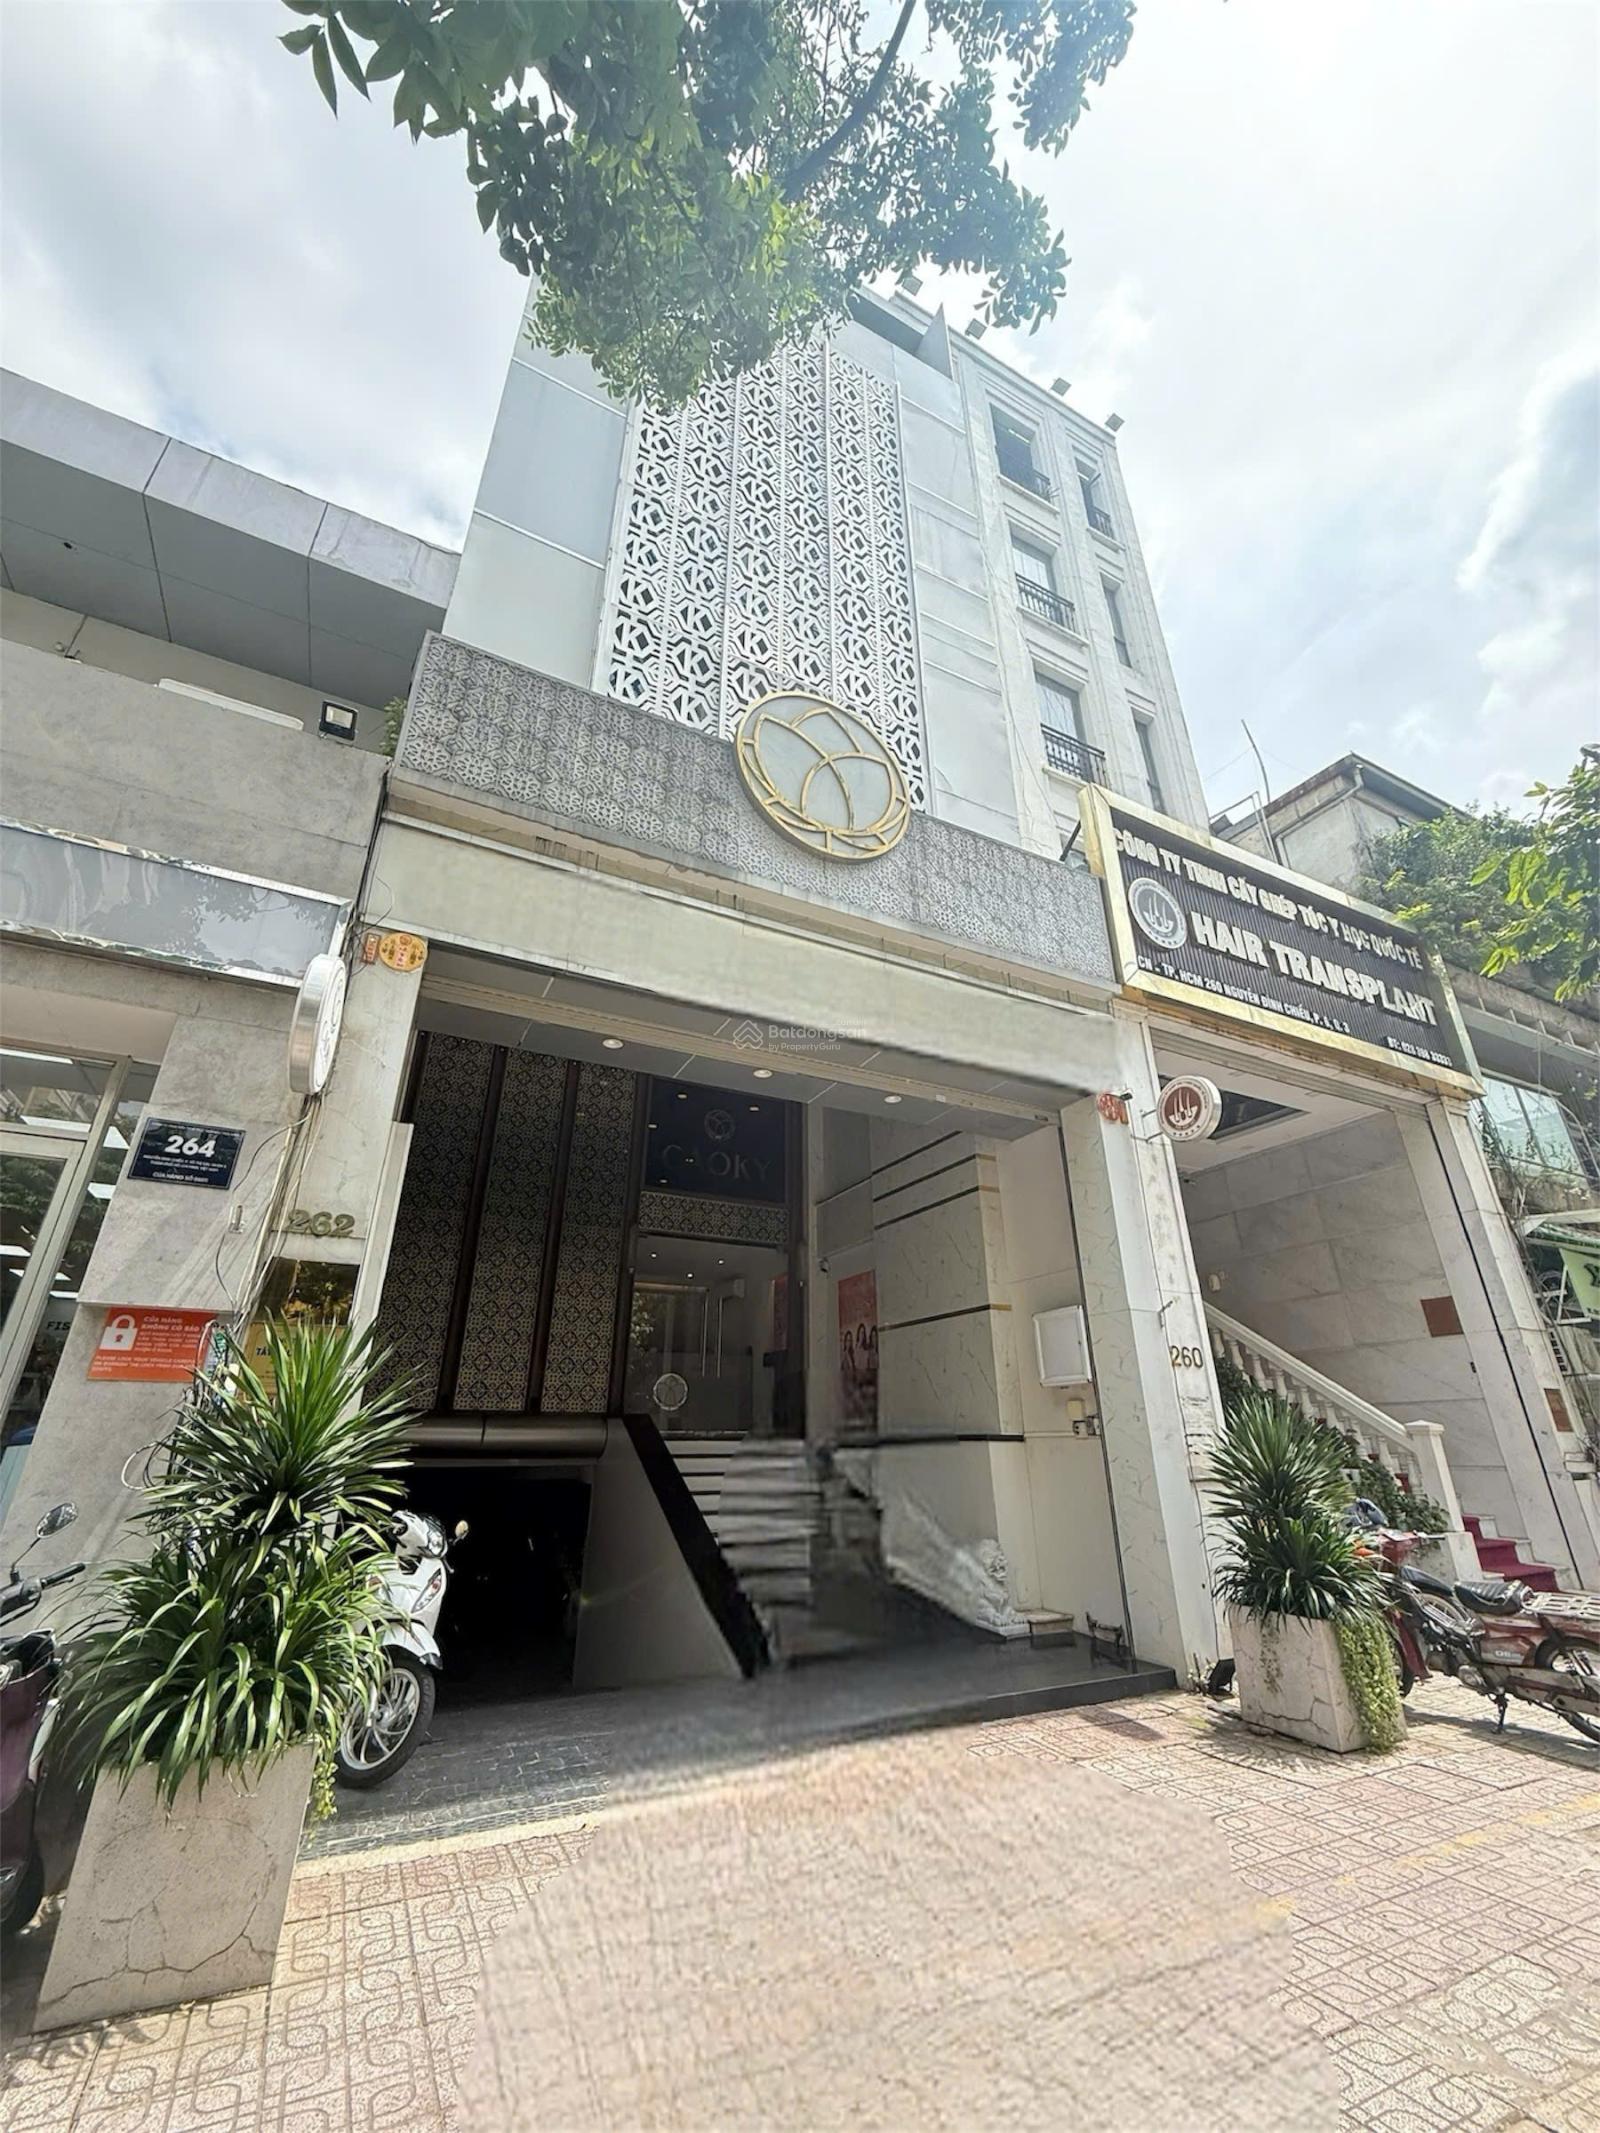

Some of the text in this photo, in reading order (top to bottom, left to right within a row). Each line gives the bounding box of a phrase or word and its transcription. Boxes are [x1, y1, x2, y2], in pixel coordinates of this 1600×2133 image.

[1159, 848, 1181, 875] TY
[1183, 857, 1228, 894] TNHH
[1297, 903, 1328, 933] TÓC
[1327, 916, 1339, 937] Y
[1340, 922, 1370, 951] HỌC
[1138, 955, 1153, 971] CN
[1161, 963, 1179, 980] TP.
[1180, 969, 1204, 987] HCM
[1204, 977, 1223, 993] 260
[1190, 911, 1437, 1025] HAIR TRANSPLANT
[164, 1135, 216, 1158] 264
[663, 1144, 776, 1184] COKY
[288, 1209, 355, 1238] 262
[1170, 1345, 1203, 1368] 260
